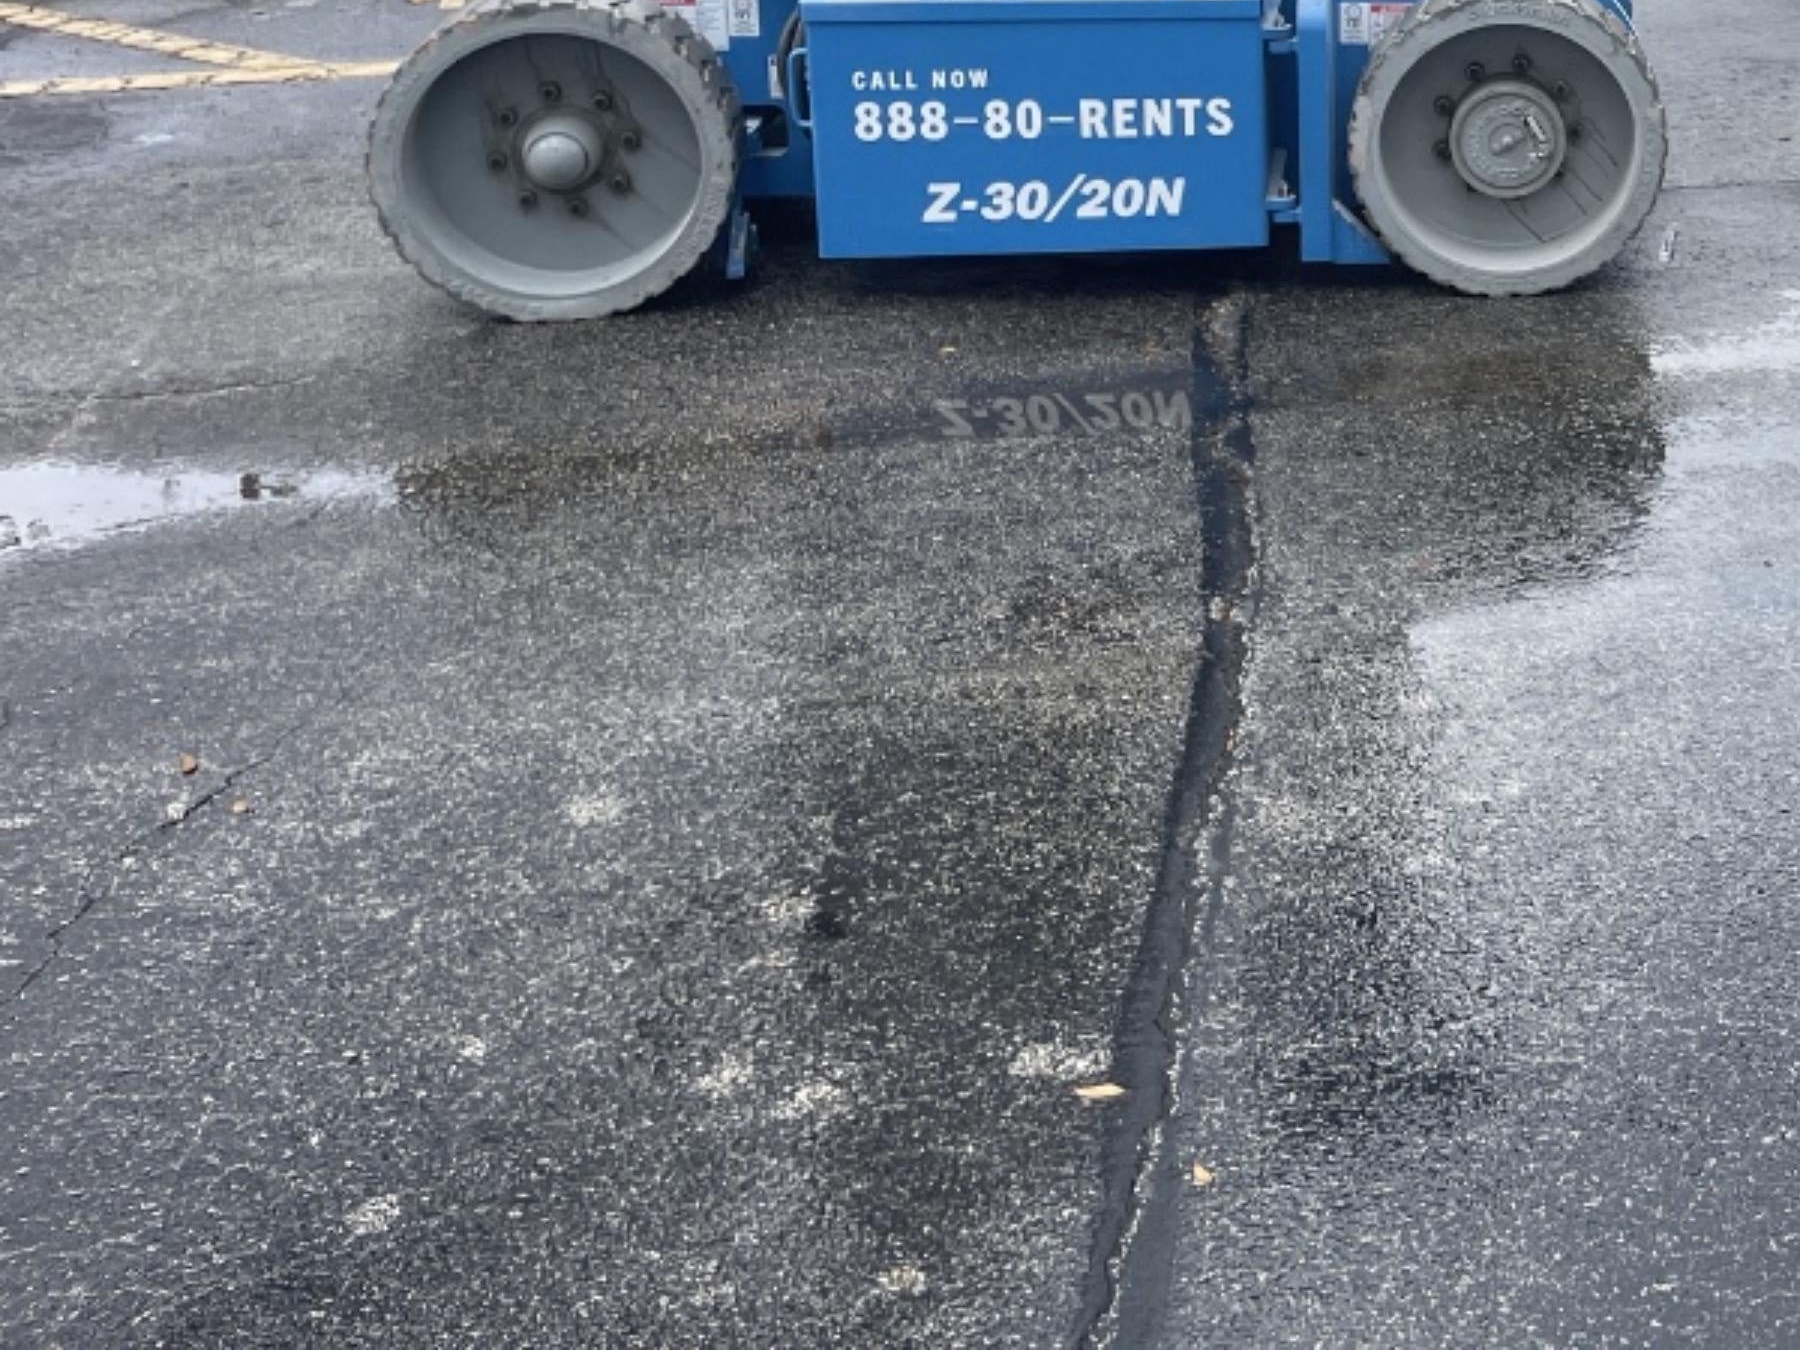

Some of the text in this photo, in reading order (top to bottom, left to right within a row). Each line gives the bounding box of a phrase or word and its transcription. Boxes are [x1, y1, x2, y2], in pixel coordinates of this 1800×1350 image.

[851, 68, 989, 91] CALL NOW
[853, 97, 1234, 142] 888-80-RENTS
[920, 173, 1186, 223] Z-30/20N
